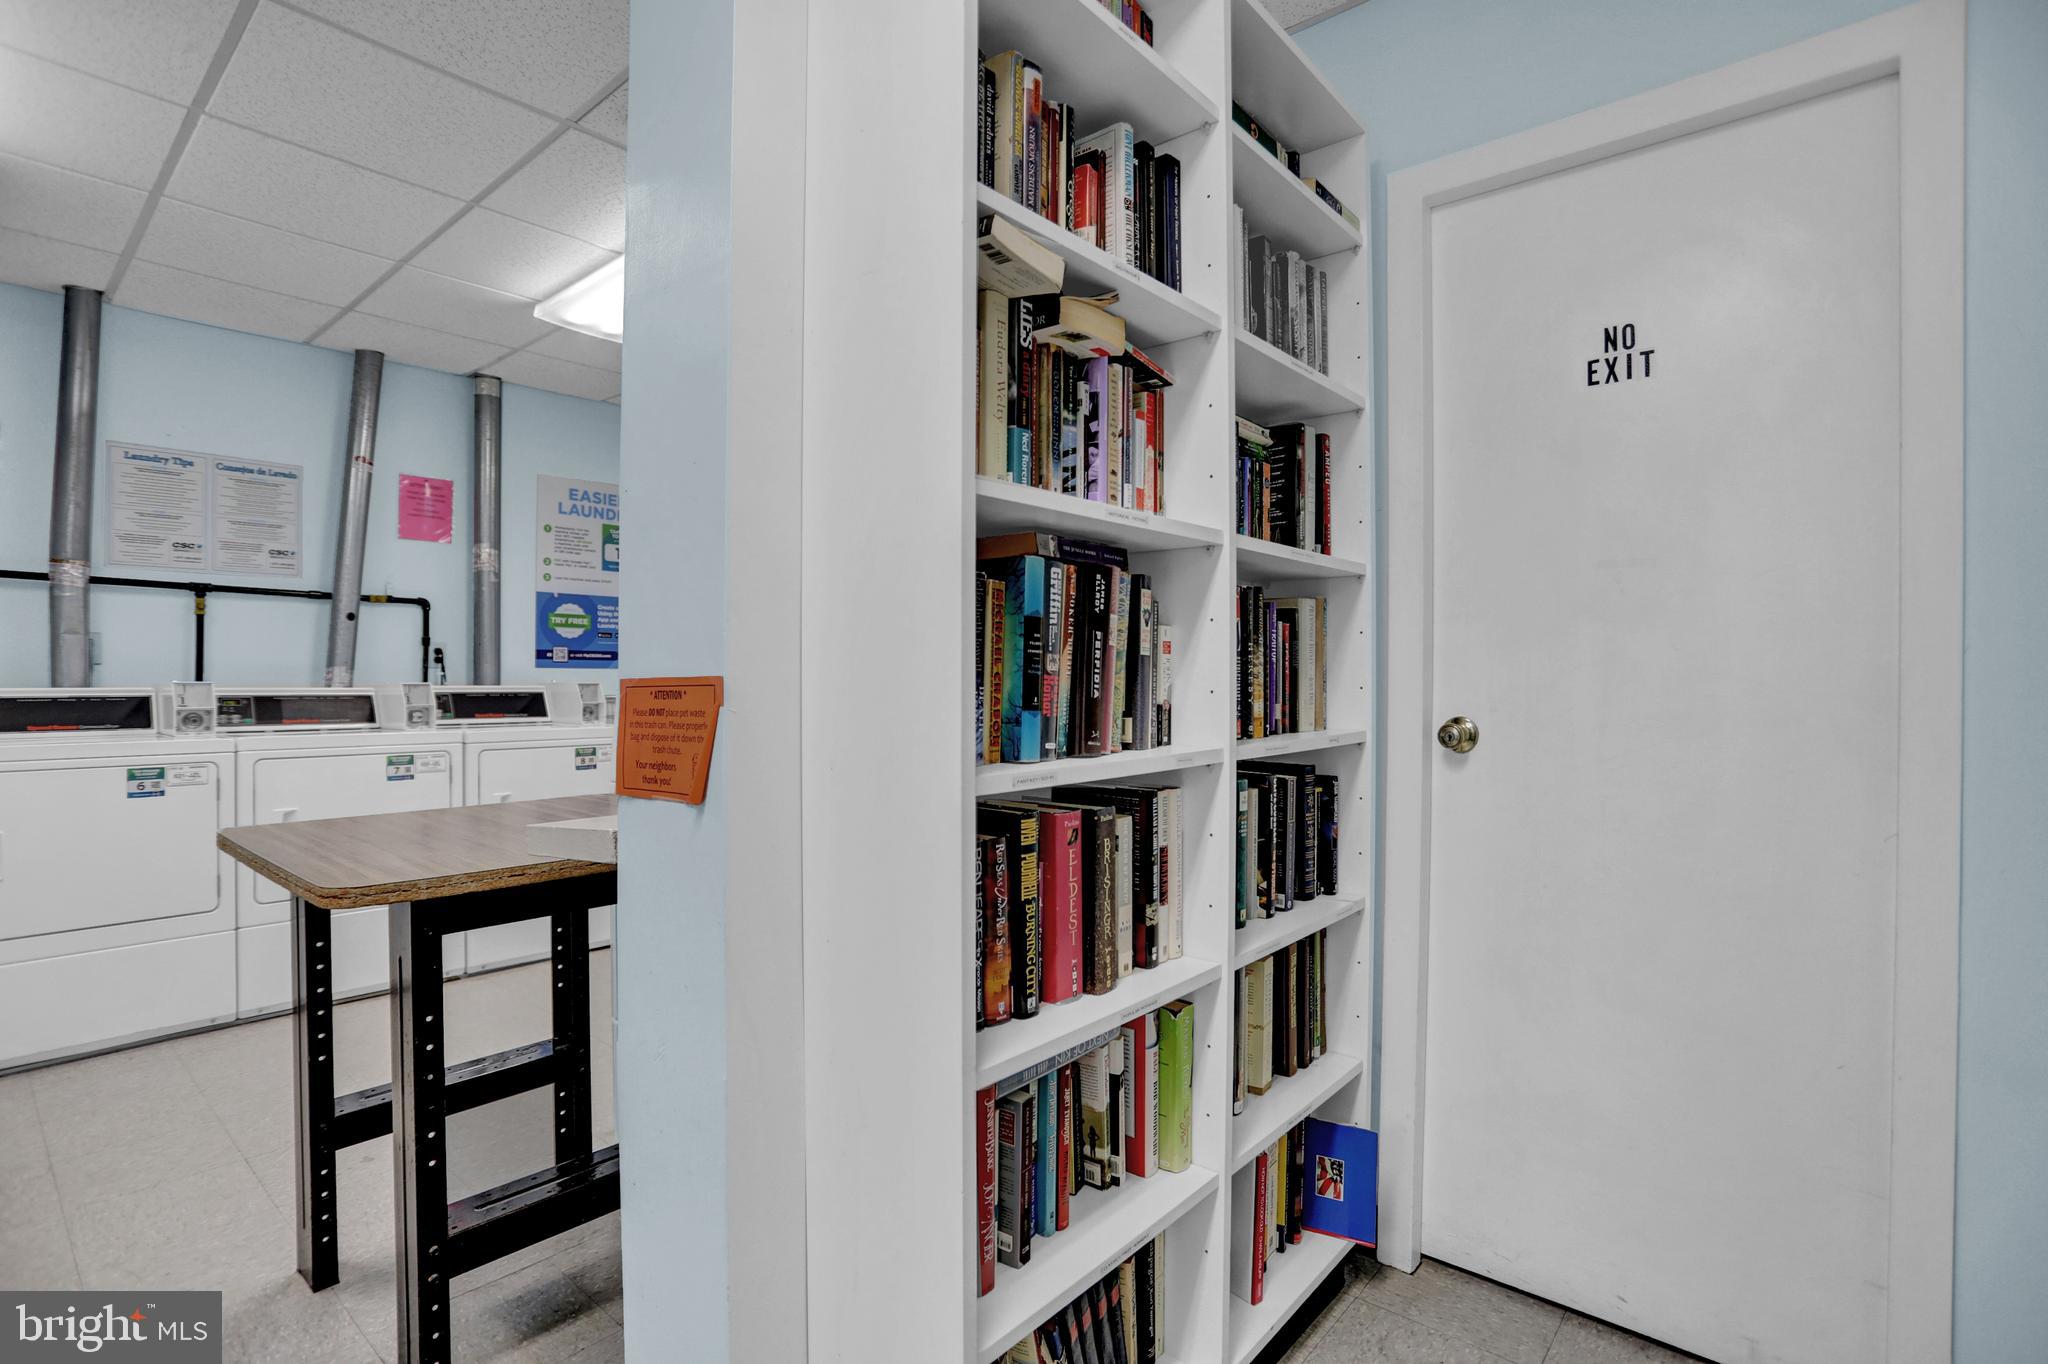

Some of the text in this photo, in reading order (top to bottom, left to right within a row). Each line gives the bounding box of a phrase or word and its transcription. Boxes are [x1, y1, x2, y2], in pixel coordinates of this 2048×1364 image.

[985, 84, 995, 156] david sedaris
[1027, 126, 1036, 206] MAIDENS MOURN
[1019, 299, 1033, 351] LIES
[1604, 323, 1636, 353] NO
[994, 319, 1007, 423] Eudora Welty
[1587, 349, 1655, 386] EXIT
[1020, 361, 1031, 398] diary
[1021, 432, 1030, 451] Ned
[123, 451, 194, 469] Laundry Tips
[215, 462, 298, 480] Consejos de Lavado
[569, 488, 619, 507] EASIE
[558, 502, 619, 522] LAUND
[1049, 567, 1062, 624] Griffin
[551, 616, 589, 625] TRY FREE
[991, 588, 1004, 748] MICHAEL CHABON
[1093, 630, 1103, 699] PERFIDIA
[653, 690, 683, 700] ATTENTION
[1042, 675, 1053, 717] Honor
[633, 708, 706, 718] Please DO NOT place pet waste
[644, 721, 657, 729] trash
[668, 721, 686, 729] Please
[630, 732, 640, 743] bag
[650, 733, 669, 743] dispose
[681, 735, 696, 743] down
[652, 746, 666, 754] trash
[635, 759, 677, 773] Your neighbors
[136, 782, 146, 790] 6
[642, 775, 659, 785] thank
[995, 844, 1005, 863] RED
[995, 864, 1005, 887] SEAS
[1160, 847, 1168, 905] SHOWDOWN
[1068, 849, 1078, 945] ELDEST
[1103, 838, 1112, 940] BRISINGR
[1020, 817, 1037, 996] NIVEN POURNELLE BURNING CITY
[995, 917, 1005, 937] RED
[995, 938, 1005, 963] SKIES
[1055, 1048, 1072, 1065] KIN
[1063, 1088, 1071, 1109] JANET
[984, 1098, 995, 1141] JENNIFER
[1061, 1110, 1070, 1145] EVANOVICH
[982, 1182, 994, 1205] JOY
